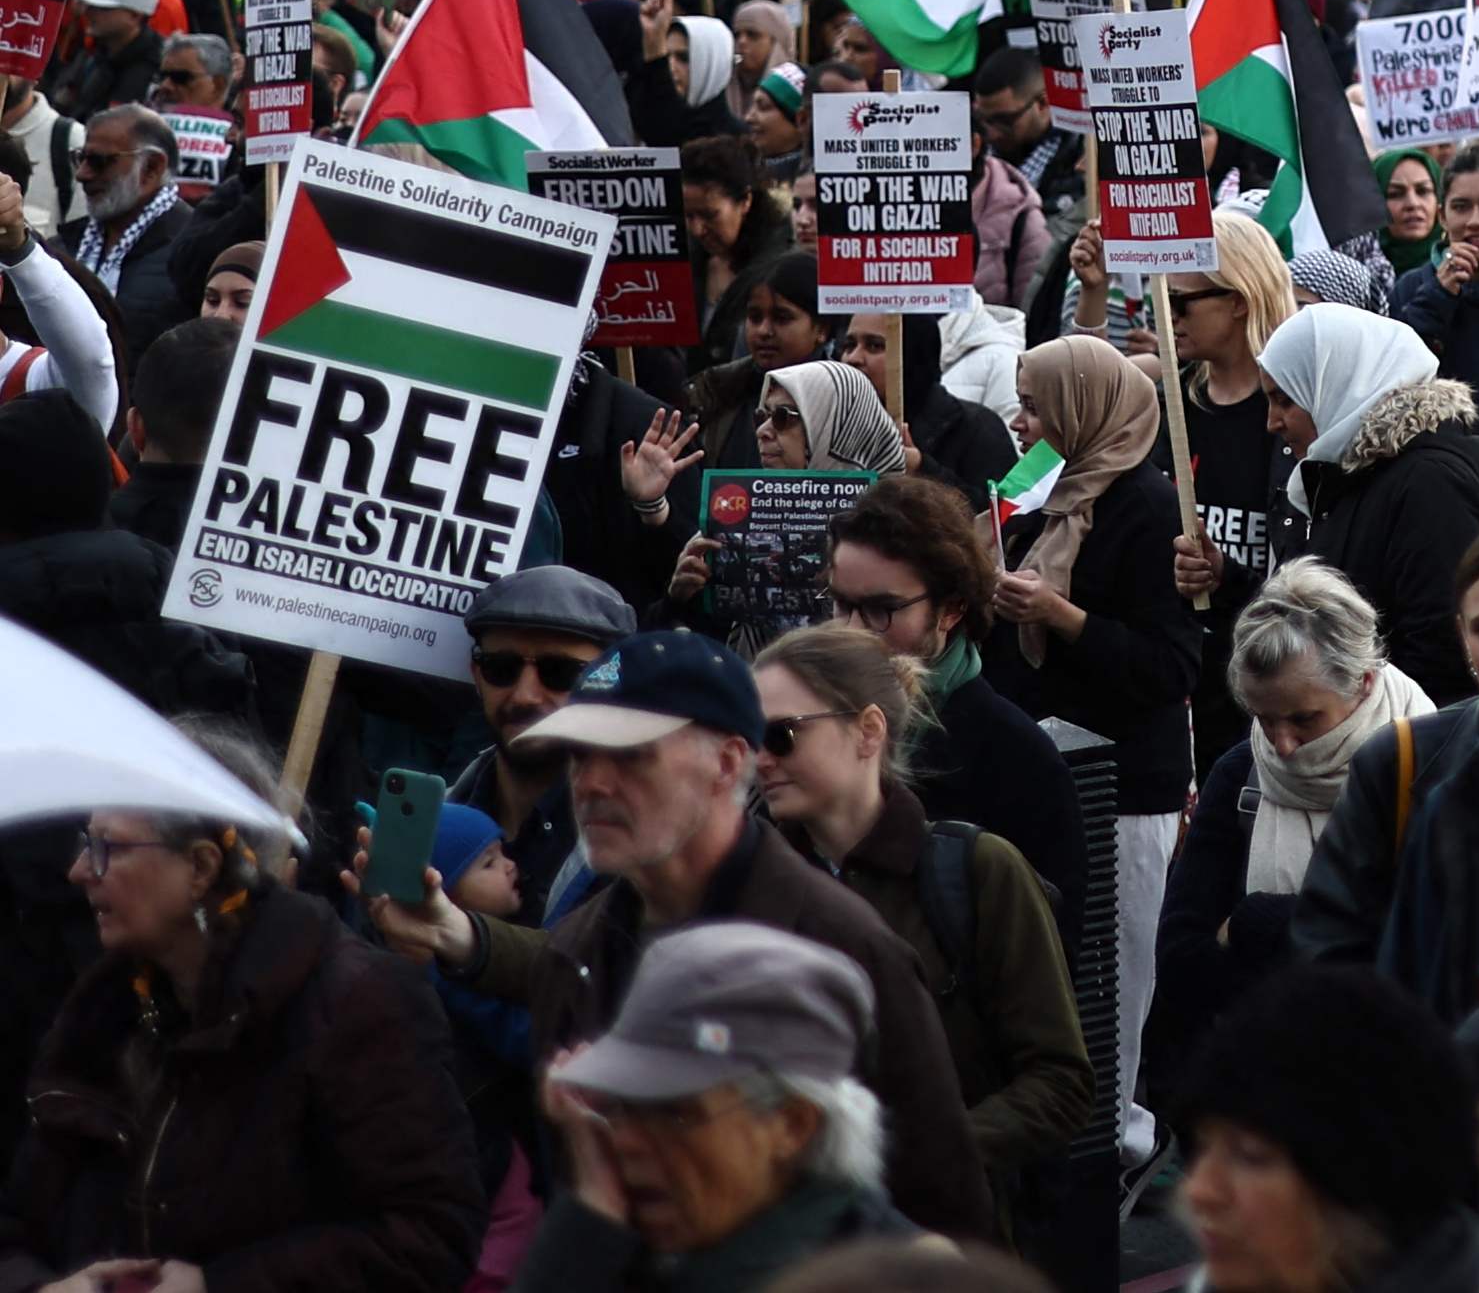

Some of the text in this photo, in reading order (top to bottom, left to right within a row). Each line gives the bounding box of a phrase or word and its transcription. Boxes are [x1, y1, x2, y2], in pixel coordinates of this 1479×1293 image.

[264, 27, 282, 53] THE
[284, 24, 311, 50] WAR
[1109, 25, 1161, 39] Socialist
[266, 54, 297, 80] GAZA!
[1091, 68, 1110, 84] MASS
[1137, 64, 1185, 83] WORKERS'
[1053, 71, 1078, 90] FOR
[1112, 86, 1160, 103] STRUGGLE TO
[869, 103, 940, 115] Socialist
[173, 116, 231, 136] ILLING
[1095, 108, 1198, 142] STOP THE WAR
[177, 139, 228, 156] DREN
[824, 138, 961, 153] MASS UNITED WORKERS'
[856, 156, 930, 170] STRUGGLE TO
[1115, 142, 1178, 176] ON GAZA!
[303, 153, 599, 247] Palestine Solidarity Campaign
[544, 177, 666, 208] FREEDOM
[819, 175, 968, 203] STOP THE WAR
[1110, 181, 1195, 208] FOR A SOCIALIST
[848, 204, 941, 231] ON GAZA!
[609, 224, 679, 256] STINE
[832, 237, 959, 259] FOR A SOCIALIST
[863, 261, 933, 283] INTIFADA
[824, 294, 948, 307] socialistparty.org.uk
[222, 349, 544, 530] FREE
[752, 480, 868, 495] Ceasefire now
[751, 497, 856, 510] End the siege of Ga
[205, 468, 513, 583] PALESTINE
[750, 522, 827, 531] Boycott Divestment
[752, 512, 828, 520] Release Palestinian
[199, 534, 475, 613] END ISRAELI OCCUPATIO
[193, 580, 218, 599] PSC
[235, 588, 437, 647] www.palestinecampaign.org
